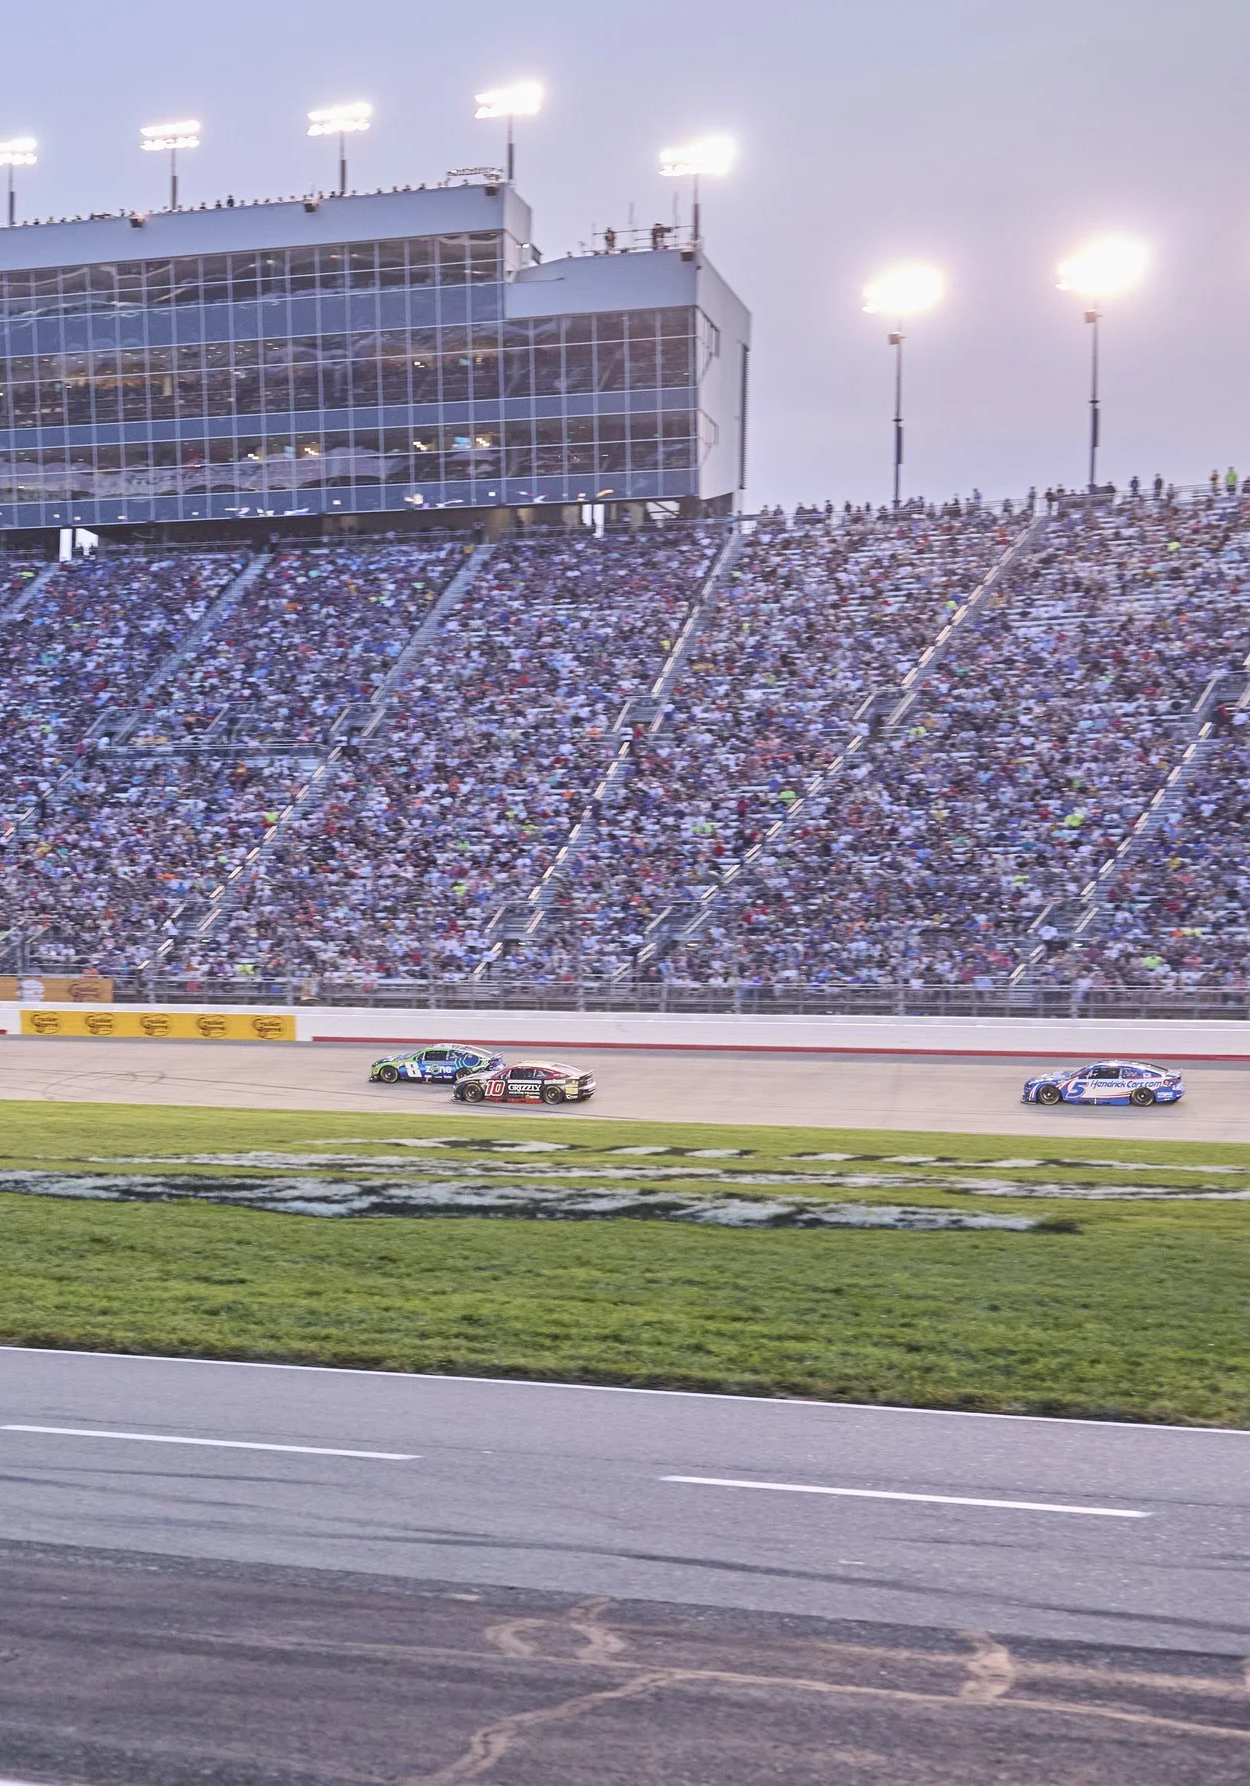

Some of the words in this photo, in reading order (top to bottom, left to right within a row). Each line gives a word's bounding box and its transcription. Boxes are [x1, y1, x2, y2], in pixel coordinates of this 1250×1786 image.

[405, 1062, 422, 1077] 8
[485, 1080, 505, 1096] 10
[508, 1084, 541, 1092] GRIZZLY
[1067, 1081, 1088, 1097] 5
